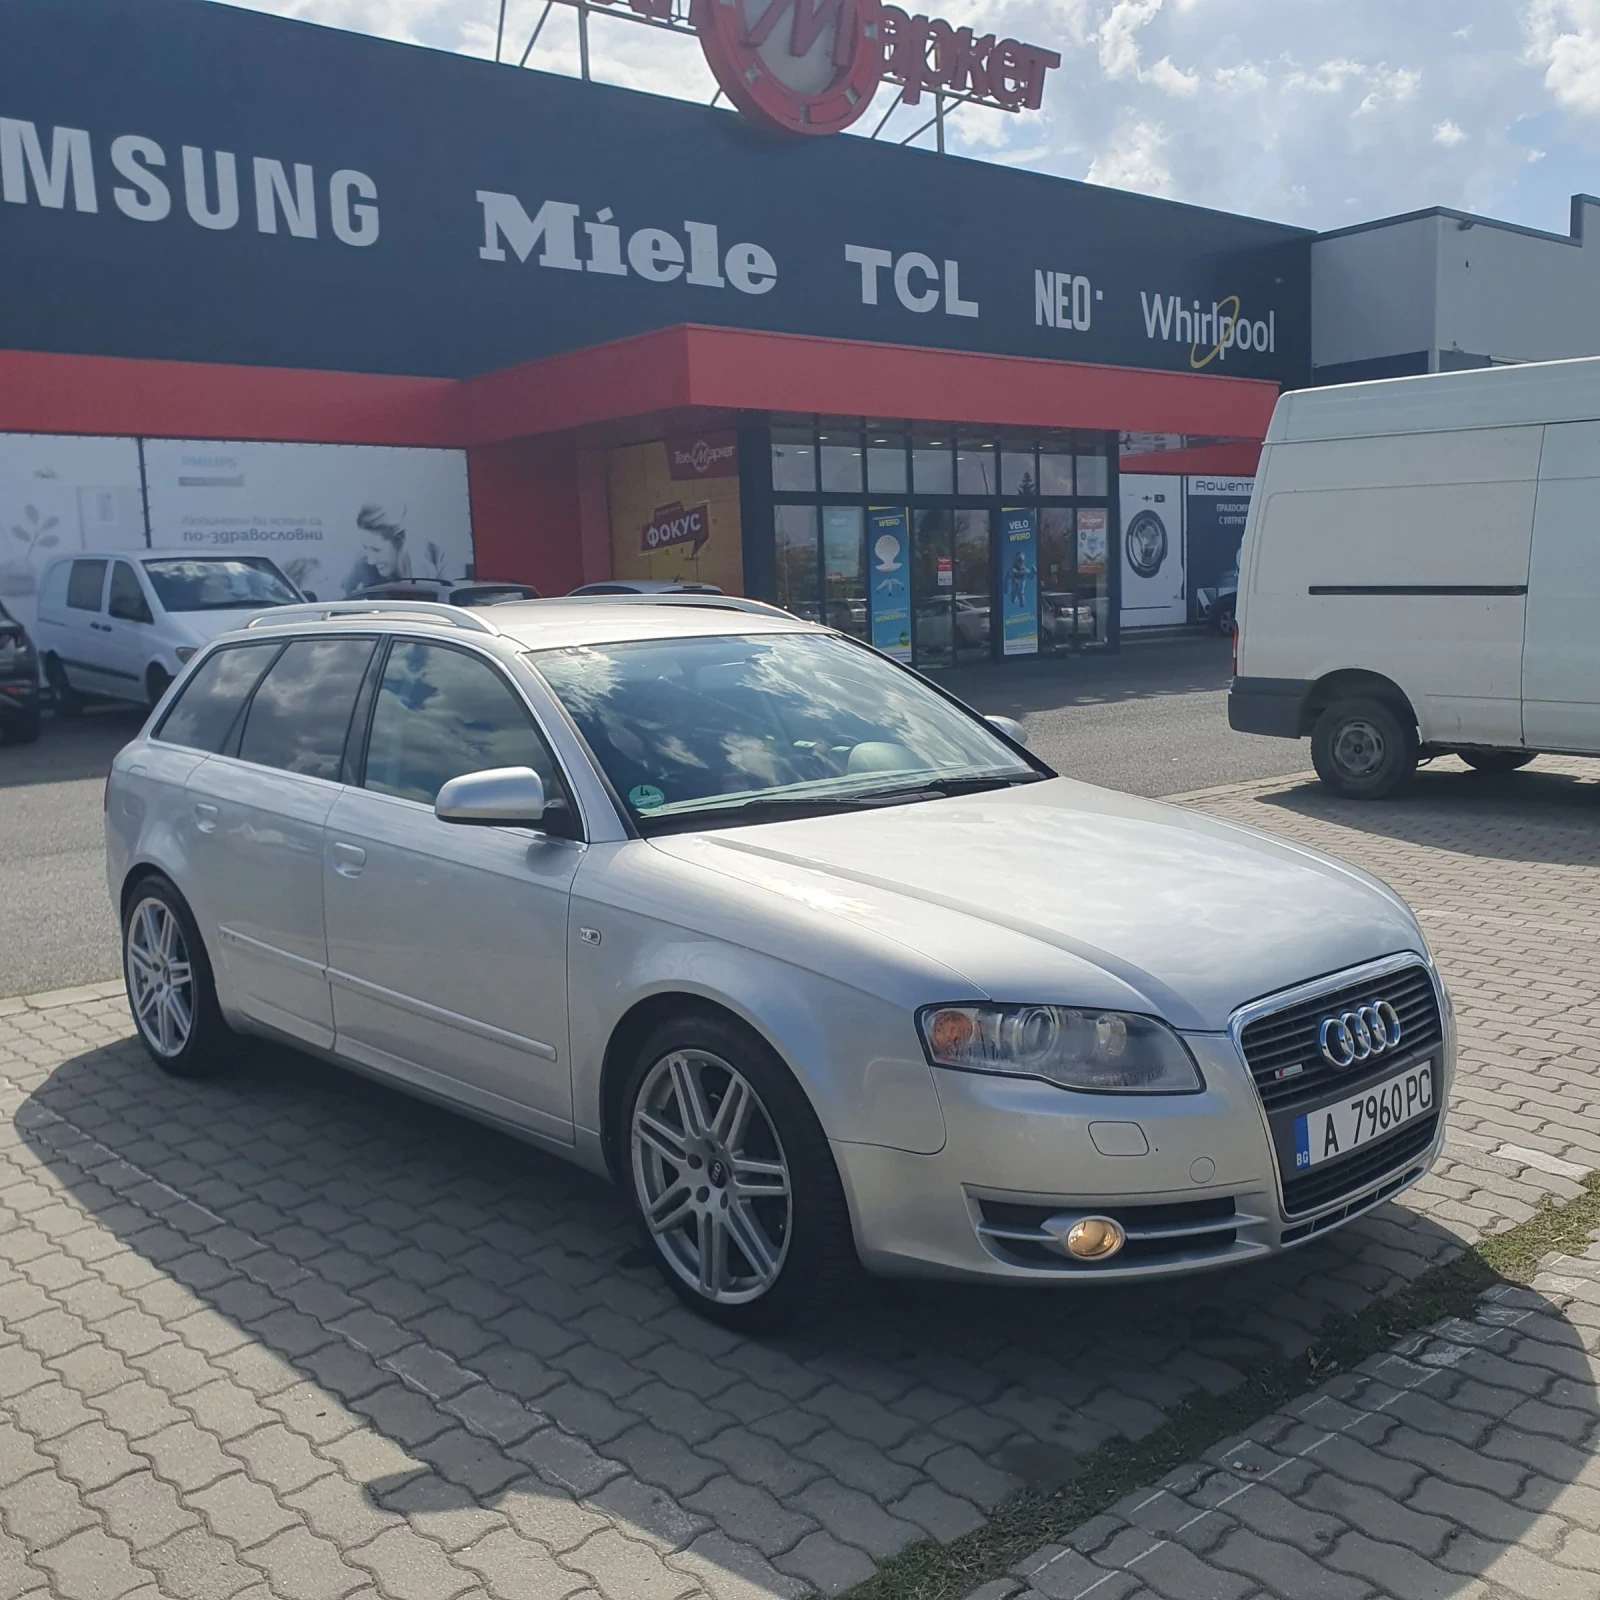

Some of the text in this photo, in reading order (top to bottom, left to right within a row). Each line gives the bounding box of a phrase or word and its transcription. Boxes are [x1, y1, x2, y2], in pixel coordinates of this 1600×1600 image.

[0, 117, 380, 247] MSUNG
[476, 189, 778, 295] Miele
[845, 243, 979, 318] TCL
[1034, 269, 1091, 331] NEO
[1141, 291, 1275, 360] Whirlpool
[183, 527, 324, 545] по-здравословни
[646, 513, 701, 547] ФОКУС
[1009, 519, 1029, 531] VELO
[1009, 531, 1031, 542] WEIRD
[1323, 1113, 1340, 1158] A
[1296, 1150, 1309, 1167] BG
